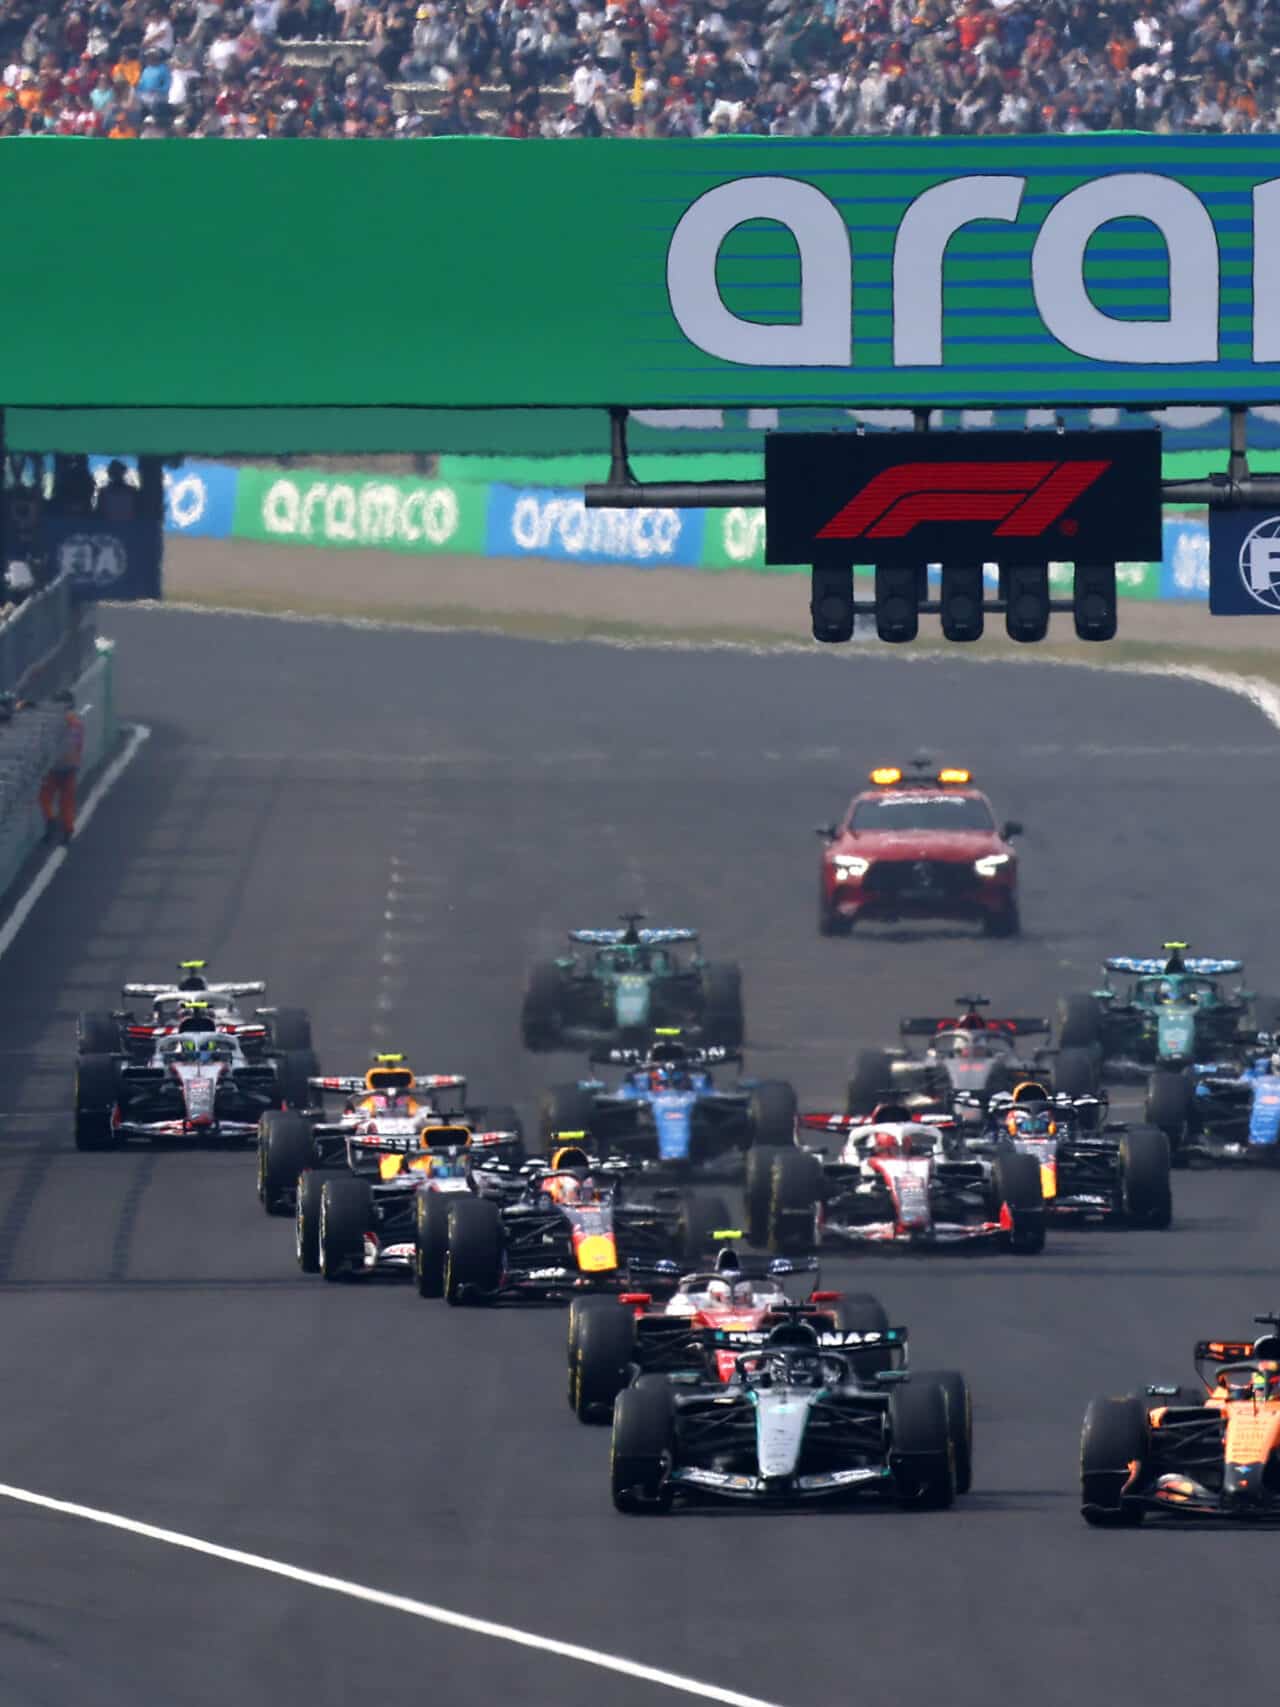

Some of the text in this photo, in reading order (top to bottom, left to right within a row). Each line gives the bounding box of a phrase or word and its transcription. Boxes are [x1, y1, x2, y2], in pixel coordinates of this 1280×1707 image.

[262, 480, 459, 545] aramco
[512, 498, 682, 557] aramco
[813, 460, 1112, 539] F1
